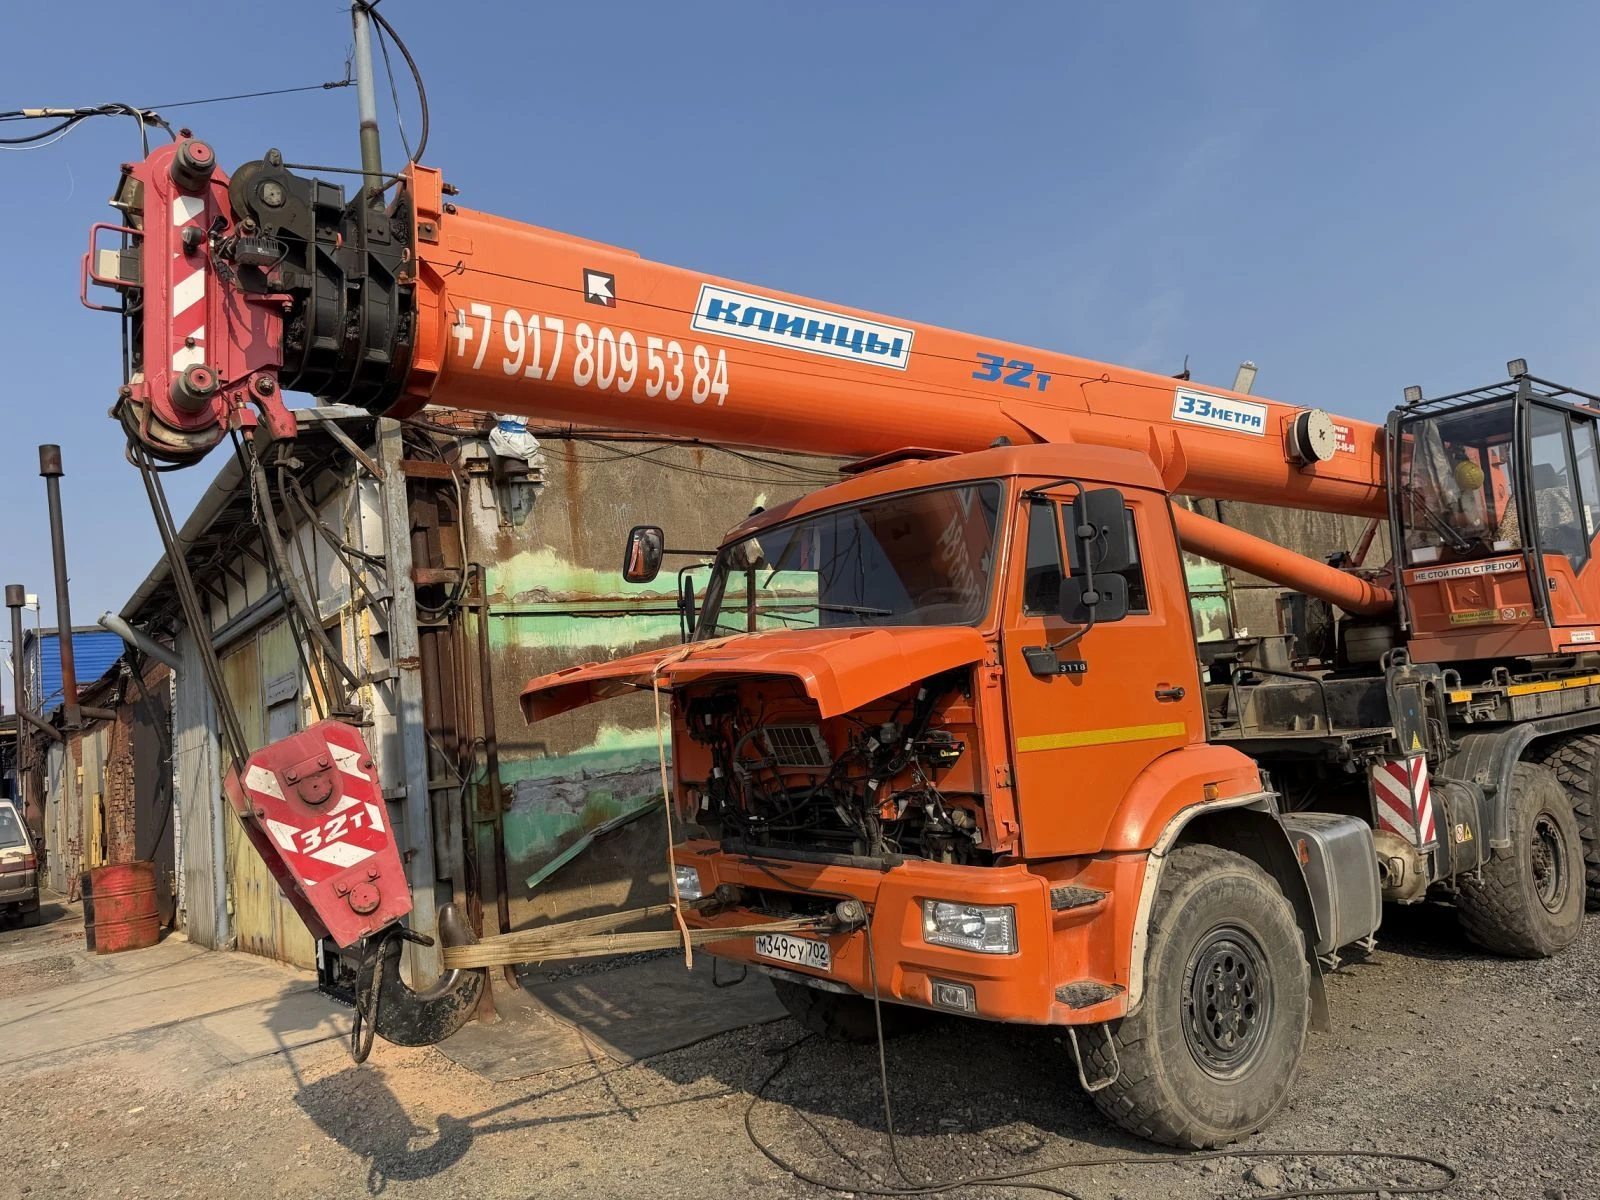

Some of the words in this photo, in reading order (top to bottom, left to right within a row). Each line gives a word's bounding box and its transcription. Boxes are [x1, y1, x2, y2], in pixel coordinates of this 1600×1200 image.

[706, 298, 904, 358] КЛИНЦЫ
[452, 303, 492, 370] +7
[503, 309, 564, 381] 917
[573, 323, 639, 393] 809
[645, 336, 684, 401] 53
[691, 345, 729, 406] 84
[1428, 568, 1449, 579] СТОЙ
[1451, 567, 1471, 576] ПОД
[1473, 560, 1519, 573] СТРЕЛОЙ
[807, 942, 826, 960] 702
